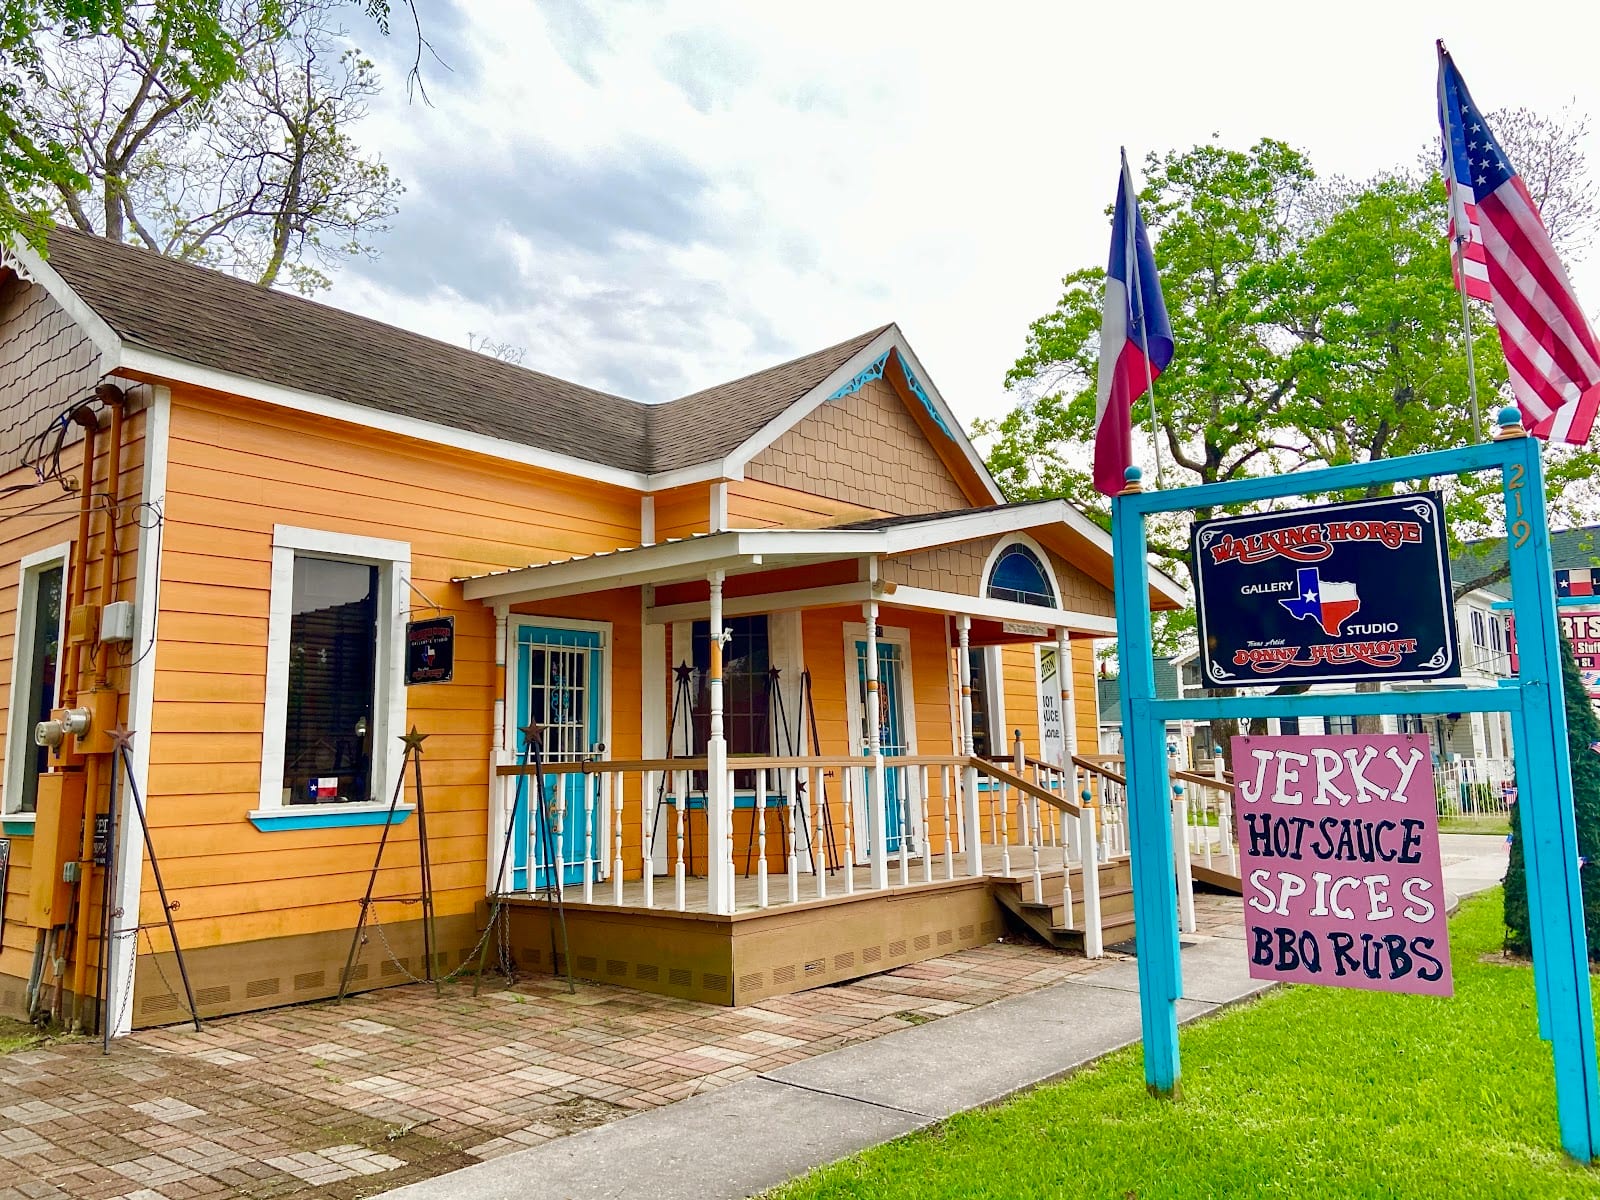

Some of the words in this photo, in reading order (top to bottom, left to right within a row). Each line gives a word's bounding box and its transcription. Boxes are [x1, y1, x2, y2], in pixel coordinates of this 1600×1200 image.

[1507, 463, 1531, 549] 219
[1209, 523, 1334, 565] WALKING
[1323, 520, 1422, 549] HORSE
[1241, 581, 1294, 595] GALLERY
[1346, 622, 1399, 636] STUDIO
[1560, 615, 1600, 639] RTS
[1233, 646, 1301, 674] DONNY
[1308, 638, 1417, 667] HICKMOTT
[1239, 745, 1424, 807] JERKY
[1243, 813, 1314, 861] HOT
[1310, 816, 1425, 864] SAUCE
[1249, 869, 1435, 924] SPICES
[1252, 926, 1322, 974] BBQ
[1327, 932, 1444, 982] RUBS
